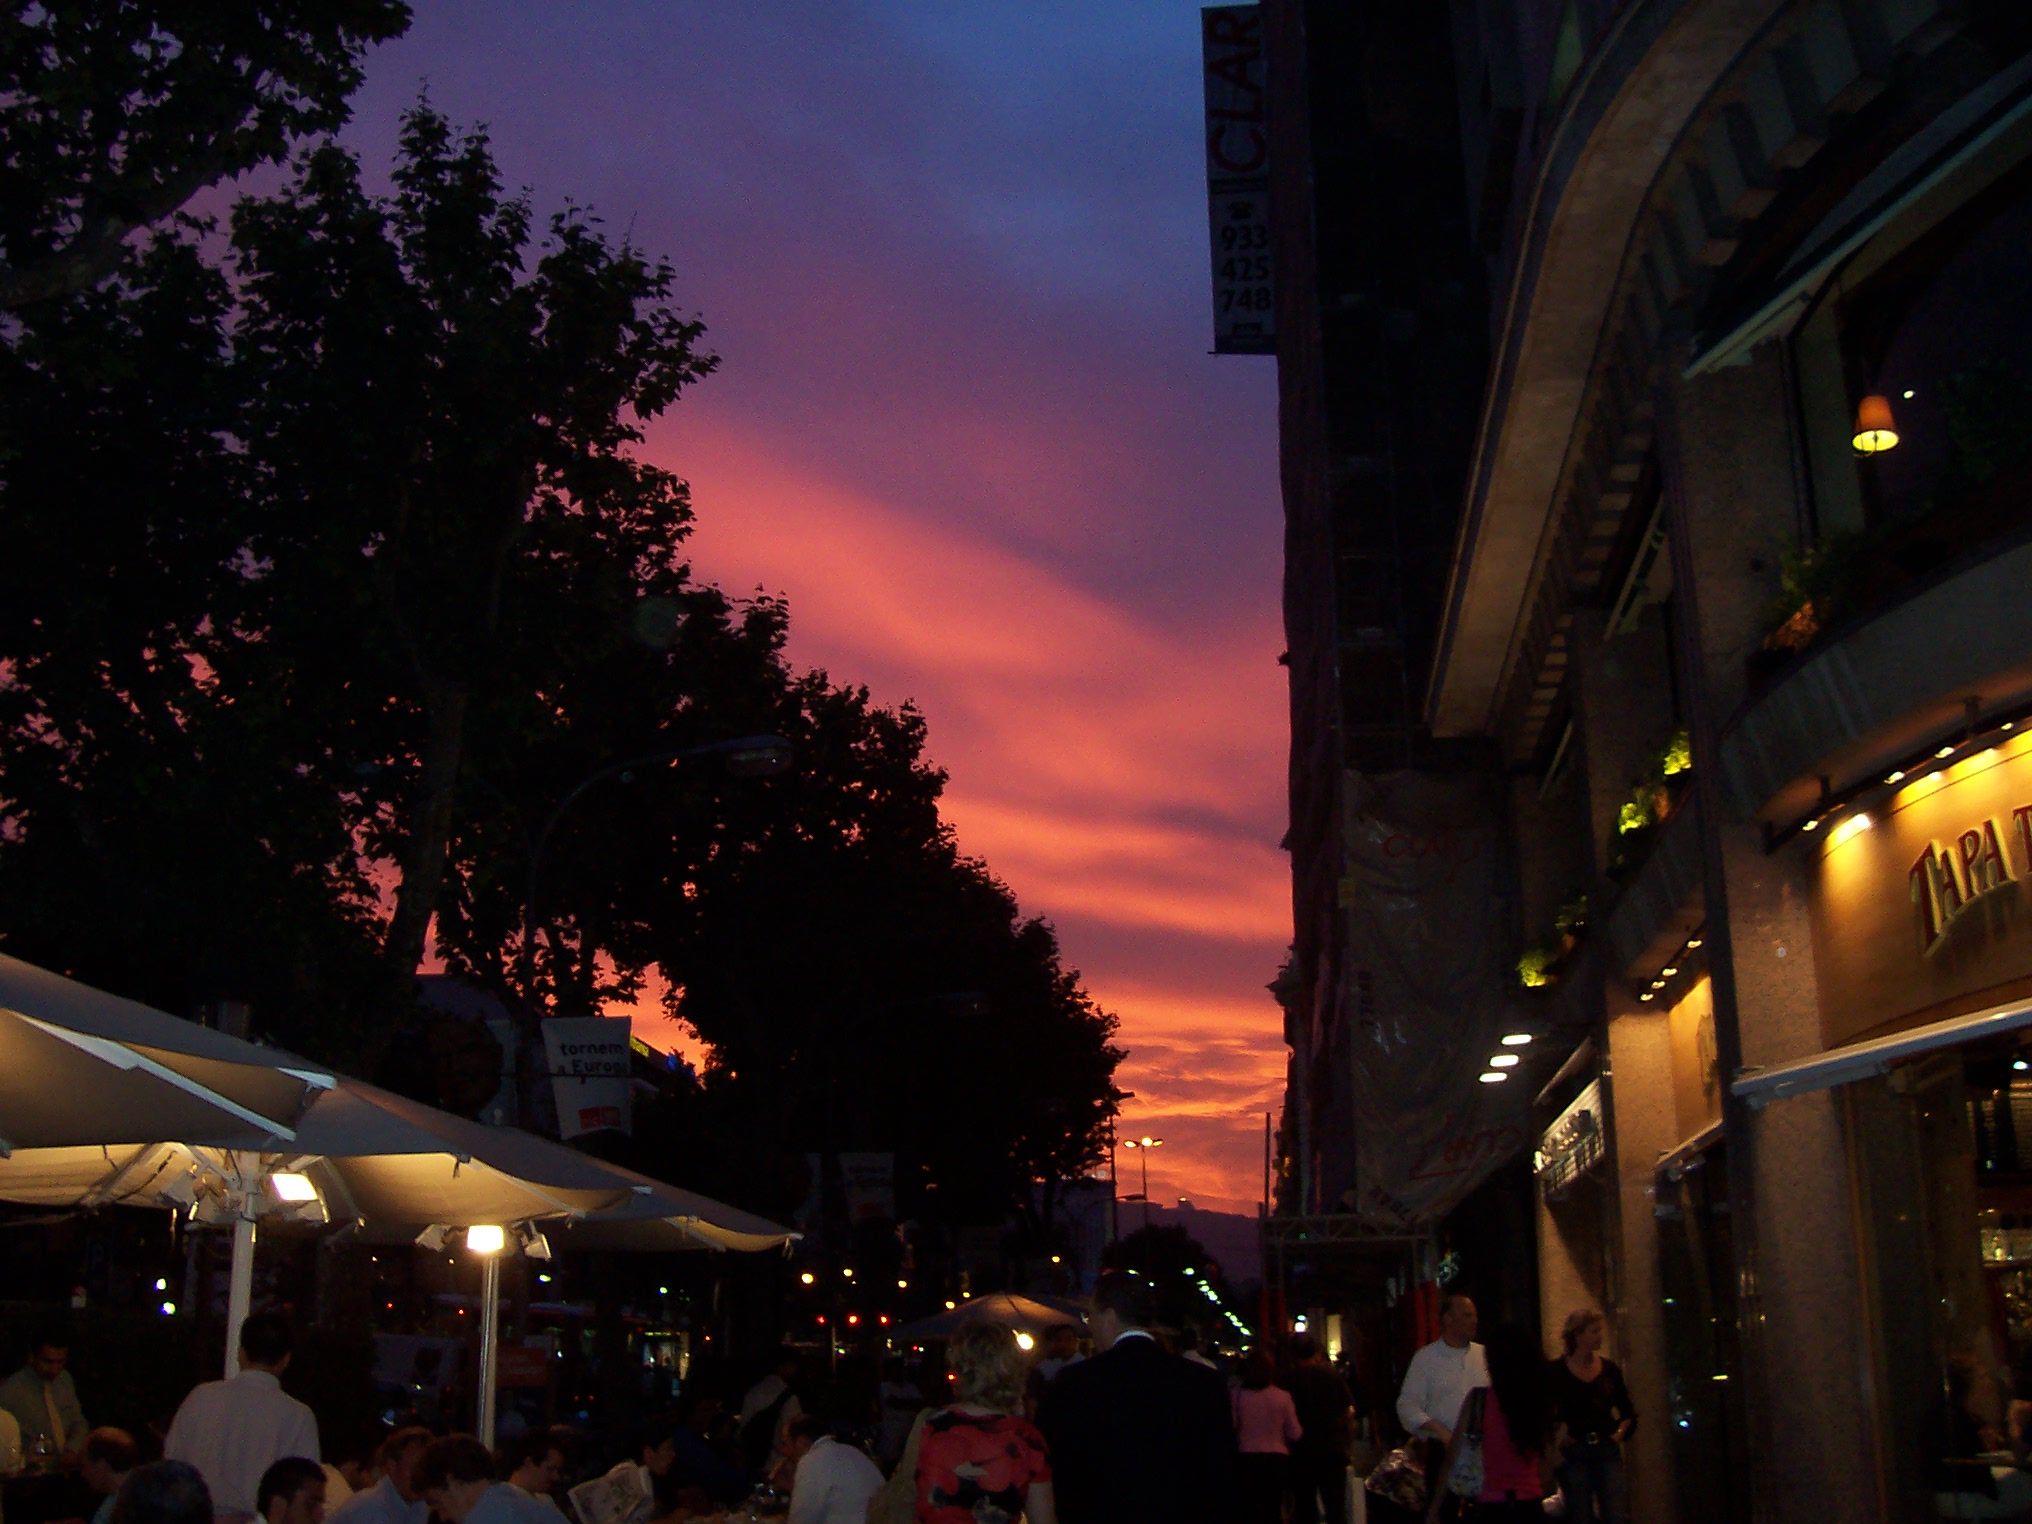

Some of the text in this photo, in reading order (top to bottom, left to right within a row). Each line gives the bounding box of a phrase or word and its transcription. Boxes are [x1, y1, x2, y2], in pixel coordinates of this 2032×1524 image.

[1207, 11, 1265, 172] CLAR
[1221, 225, 1268, 250] 933
[1221, 256, 1269, 281] 425
[1221, 287, 1271, 312] 748
[1908, 817, 2014, 952] TAPA
[560, 1043, 624, 1055] tornem
